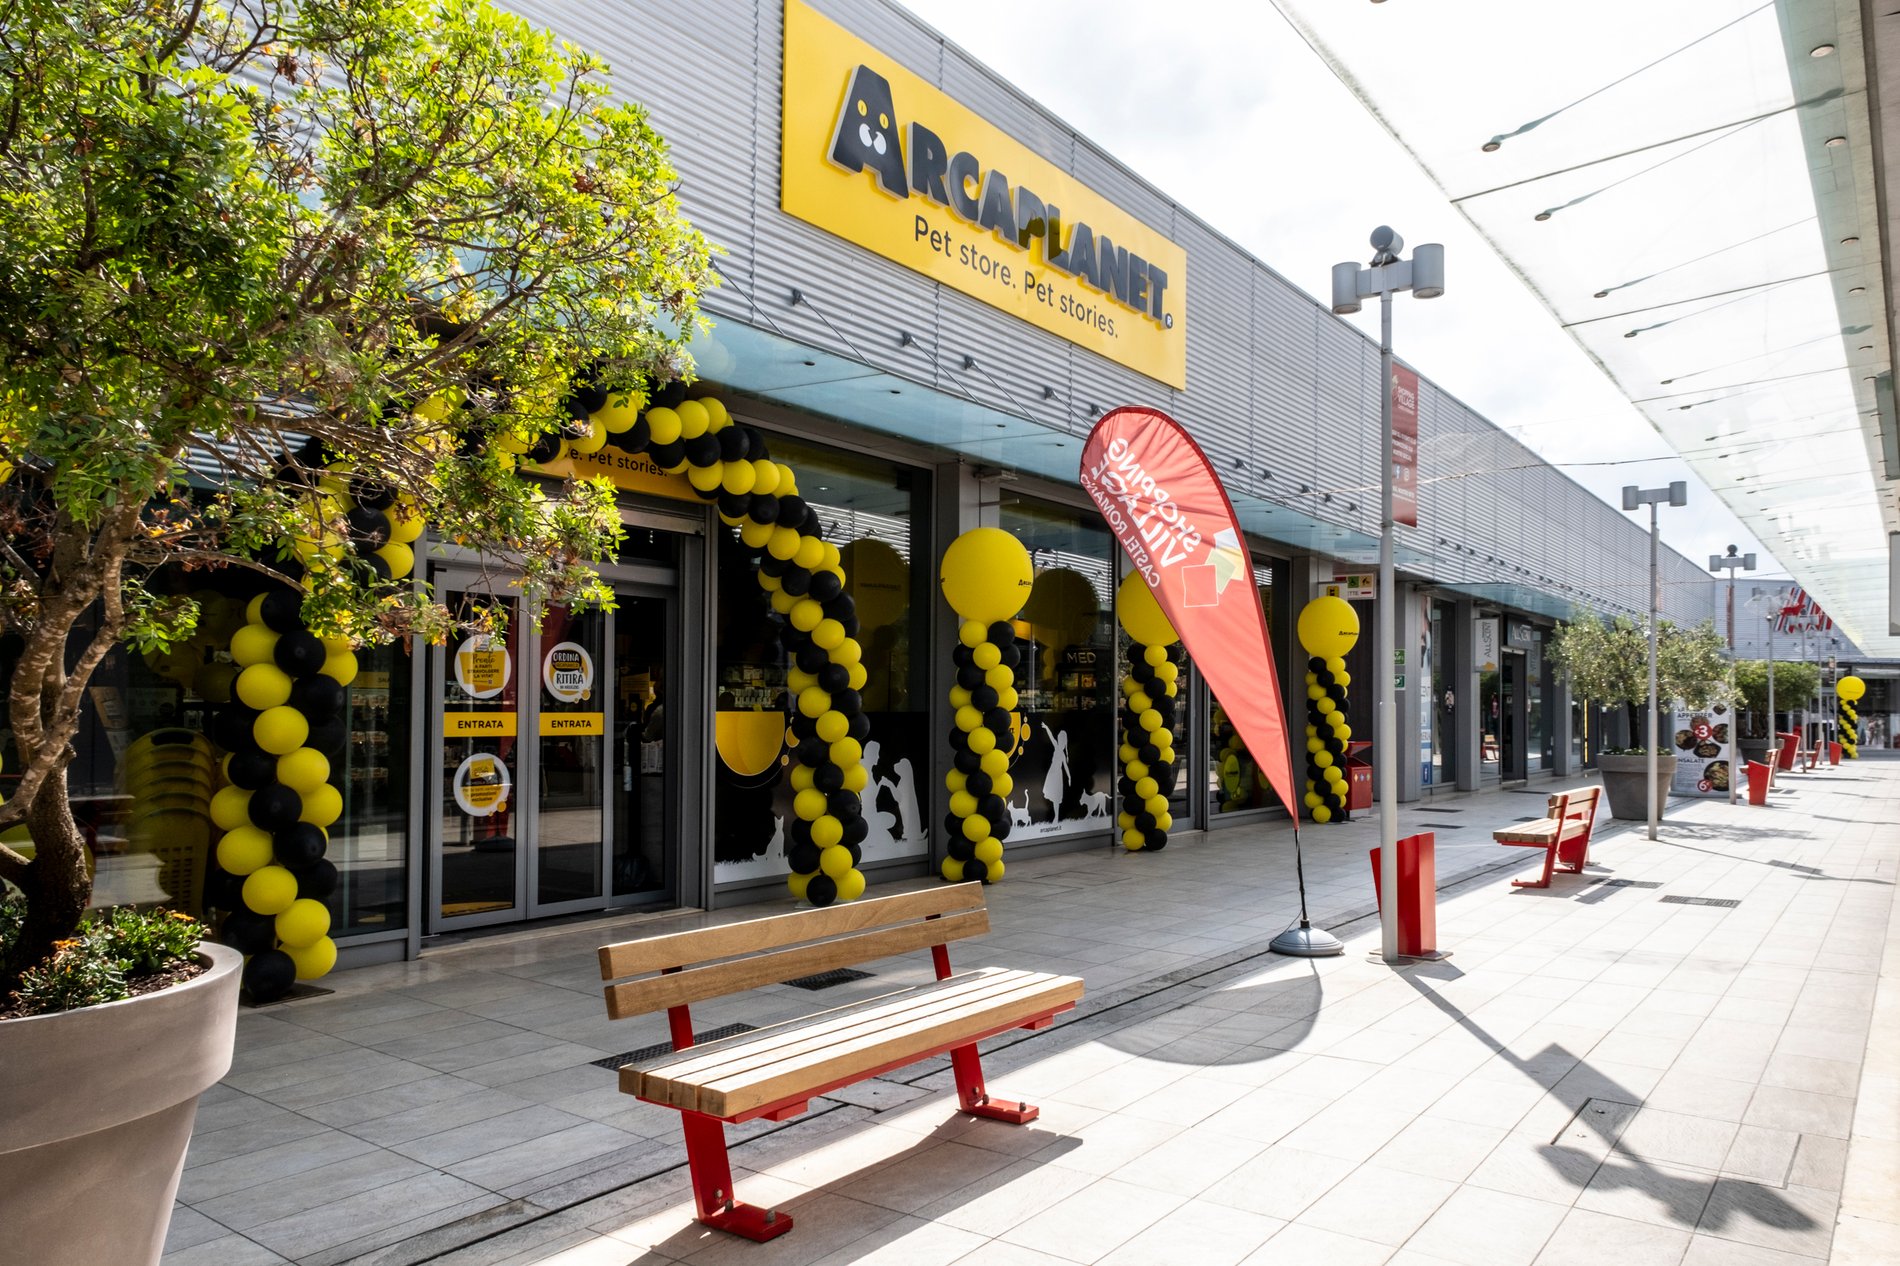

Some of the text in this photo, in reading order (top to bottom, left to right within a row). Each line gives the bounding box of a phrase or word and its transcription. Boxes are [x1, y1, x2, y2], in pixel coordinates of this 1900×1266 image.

[914, 214, 1118, 338] Pet store. Pet stories.
[588, 451, 614, 465] Pet
[617, 456, 668, 477] stories.
[553, 653, 580, 662] ORDINA
[556, 673, 584, 684] RITIRA
[457, 720, 504, 729] ENTRATA
[551, 720, 592, 728] ENTRATA
